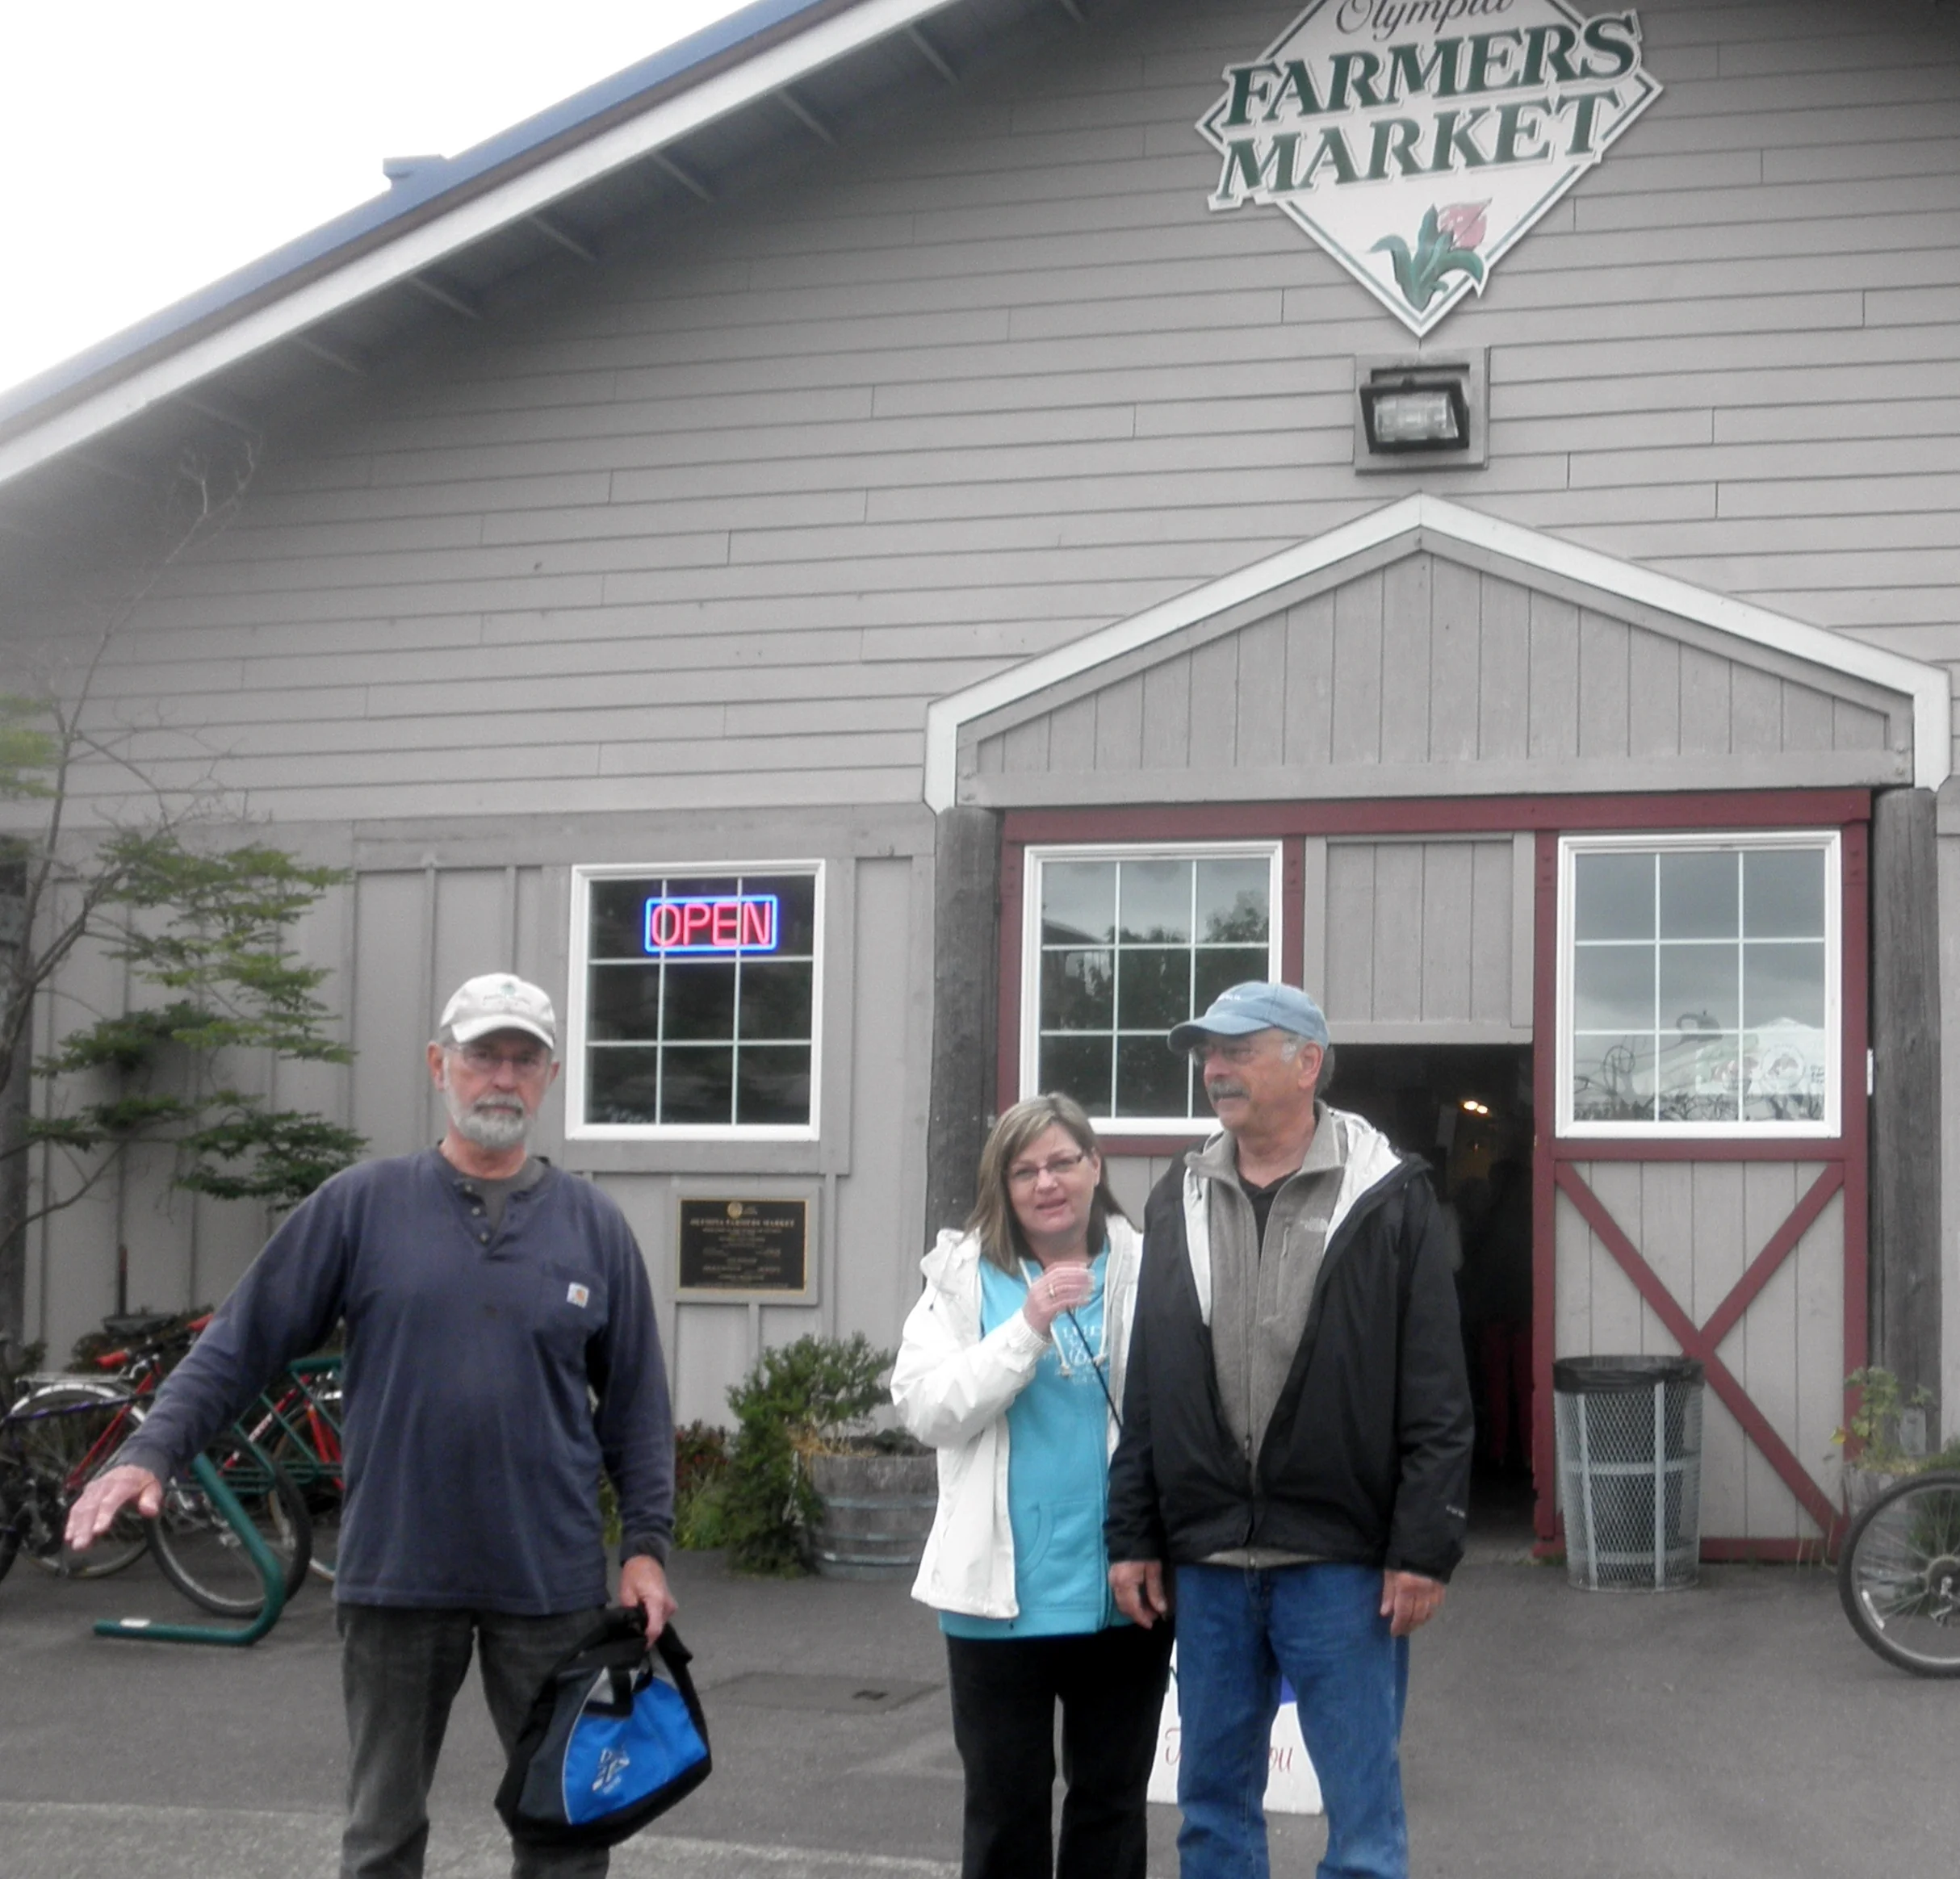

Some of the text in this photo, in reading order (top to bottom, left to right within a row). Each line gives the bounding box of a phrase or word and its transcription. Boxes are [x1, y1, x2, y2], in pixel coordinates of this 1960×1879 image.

[1221, 11, 1640, 128] FARMERS
[1216, 91, 1624, 202] MARKET
[651, 901, 771, 947] OPEN
